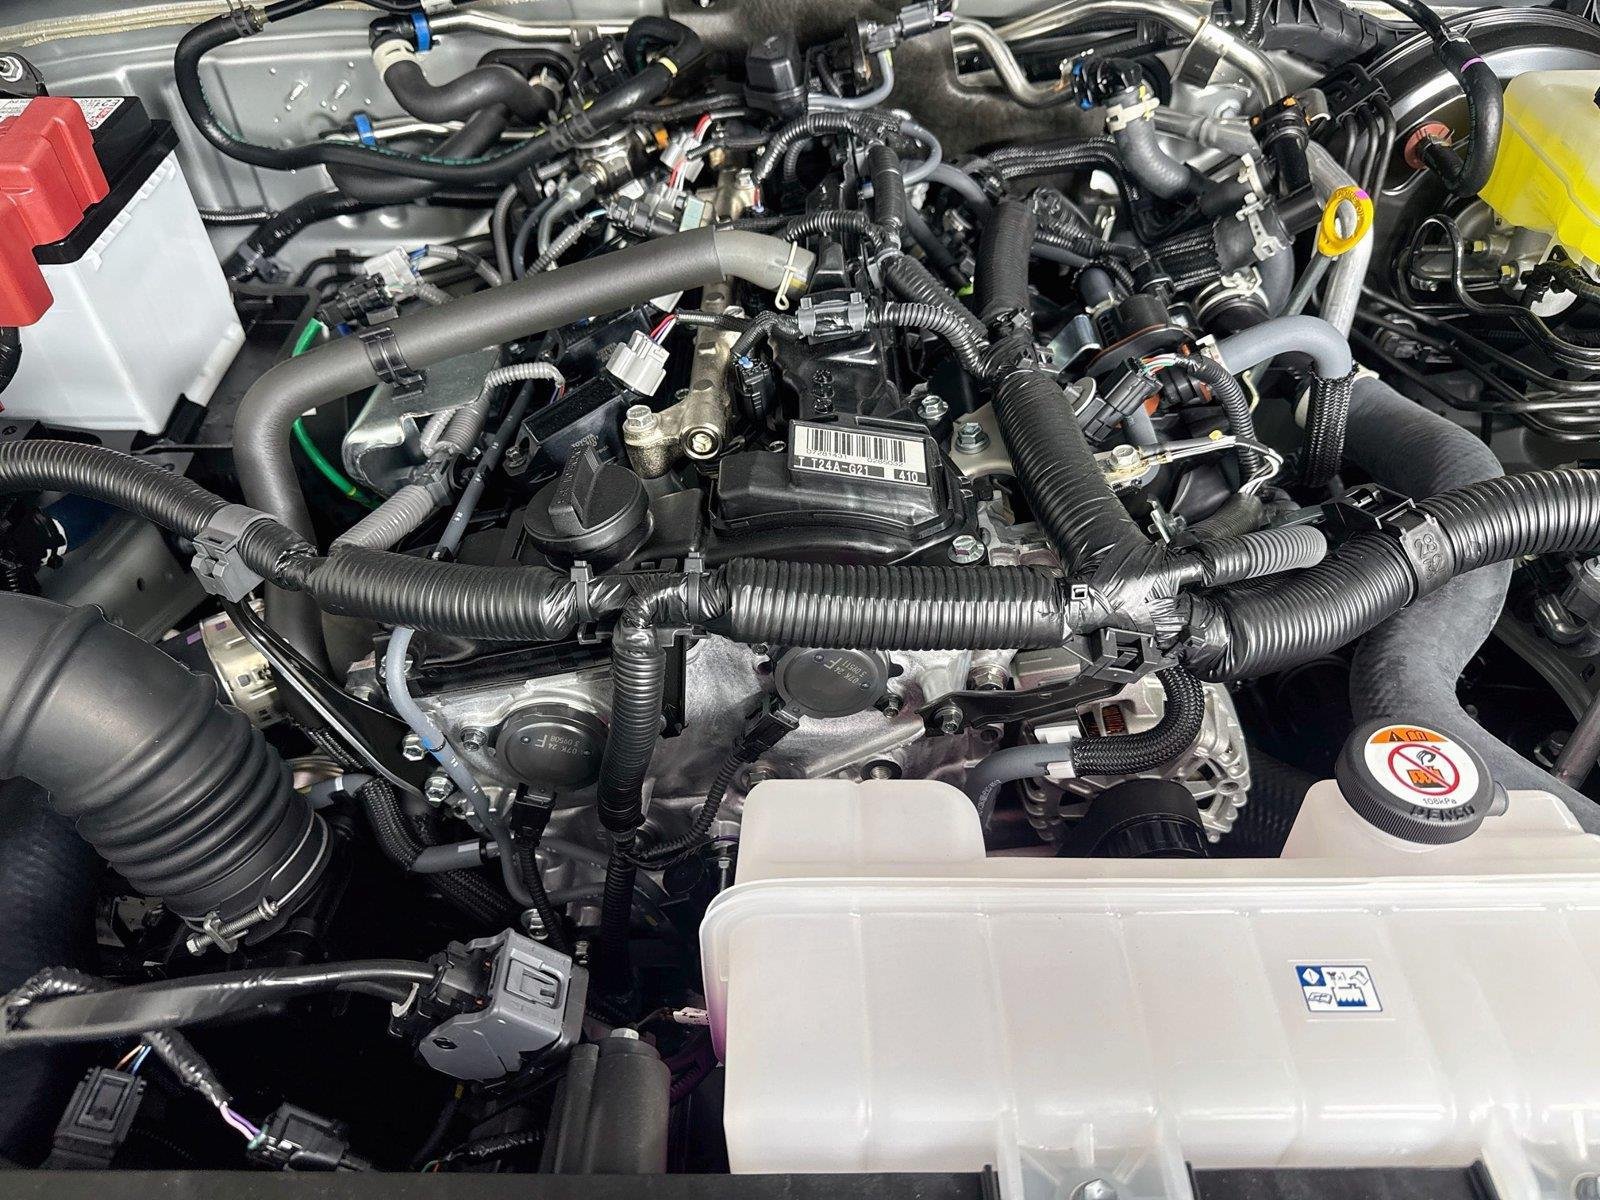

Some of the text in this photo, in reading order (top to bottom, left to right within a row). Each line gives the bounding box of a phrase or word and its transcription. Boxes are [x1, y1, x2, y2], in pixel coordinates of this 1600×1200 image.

[798, 456, 919, 483] T T24A-G21 410
[824, 657, 843, 670] F
[534, 734, 548, 749] F
[1422, 797, 1458, 806] 108kPa
